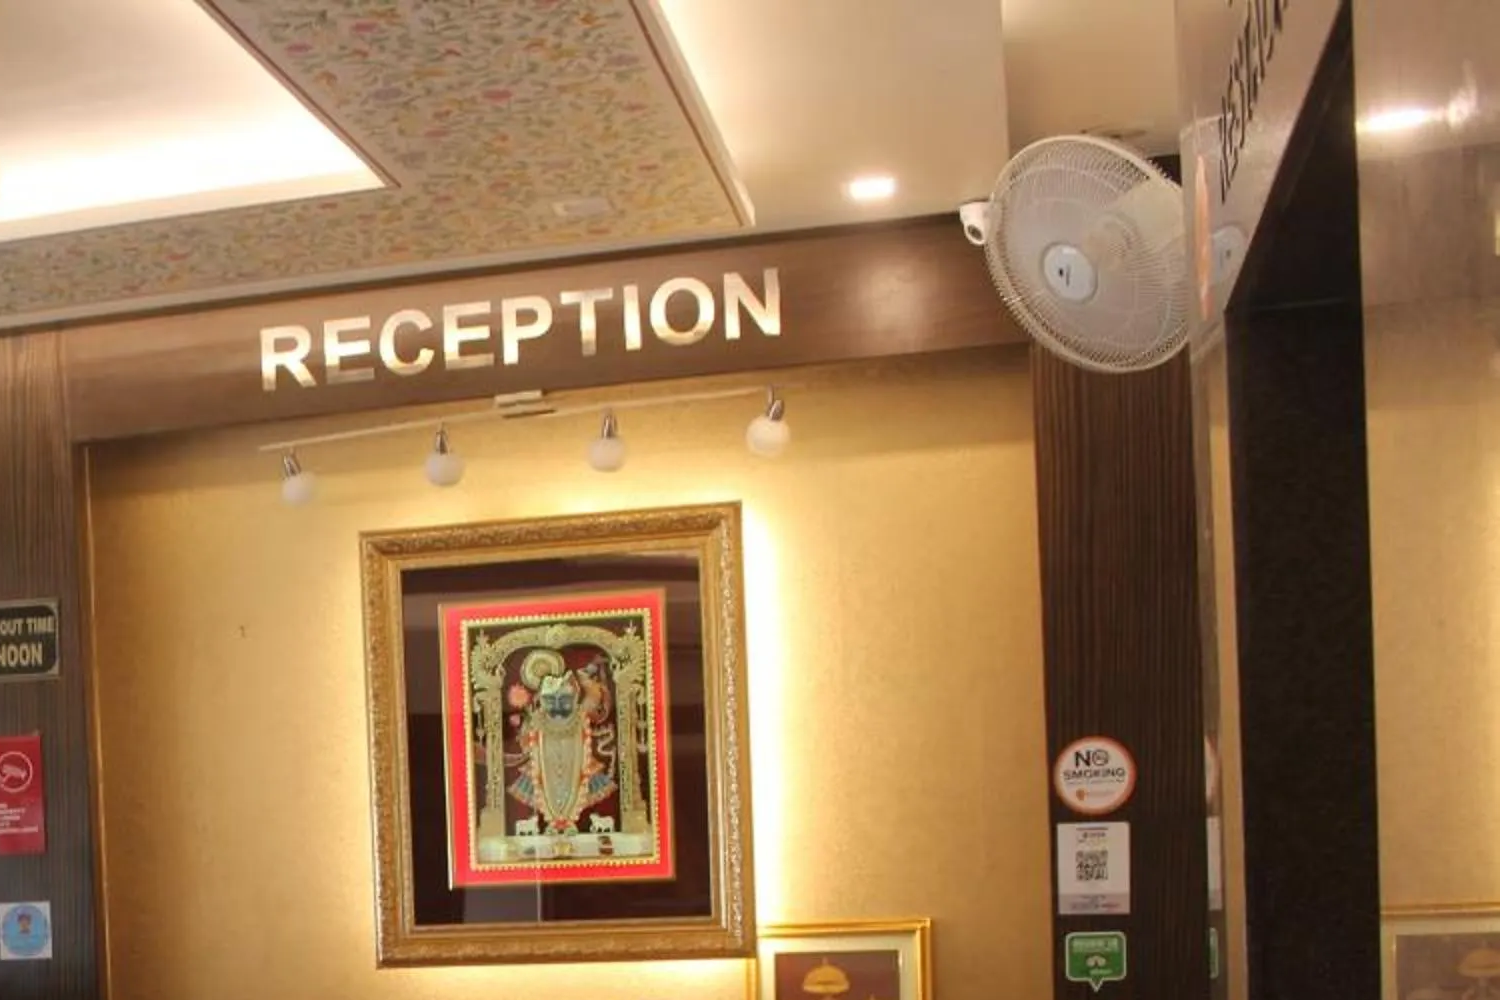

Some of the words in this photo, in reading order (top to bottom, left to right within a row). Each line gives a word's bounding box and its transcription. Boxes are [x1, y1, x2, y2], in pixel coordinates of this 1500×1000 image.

[259, 268, 781, 391] RECEPTION
[0, 617, 24, 636] OUT
[25, 615, 55, 635] TIME
[1074, 749, 1110, 767] NO
[1063, 767, 1126, 780] SMOKING
